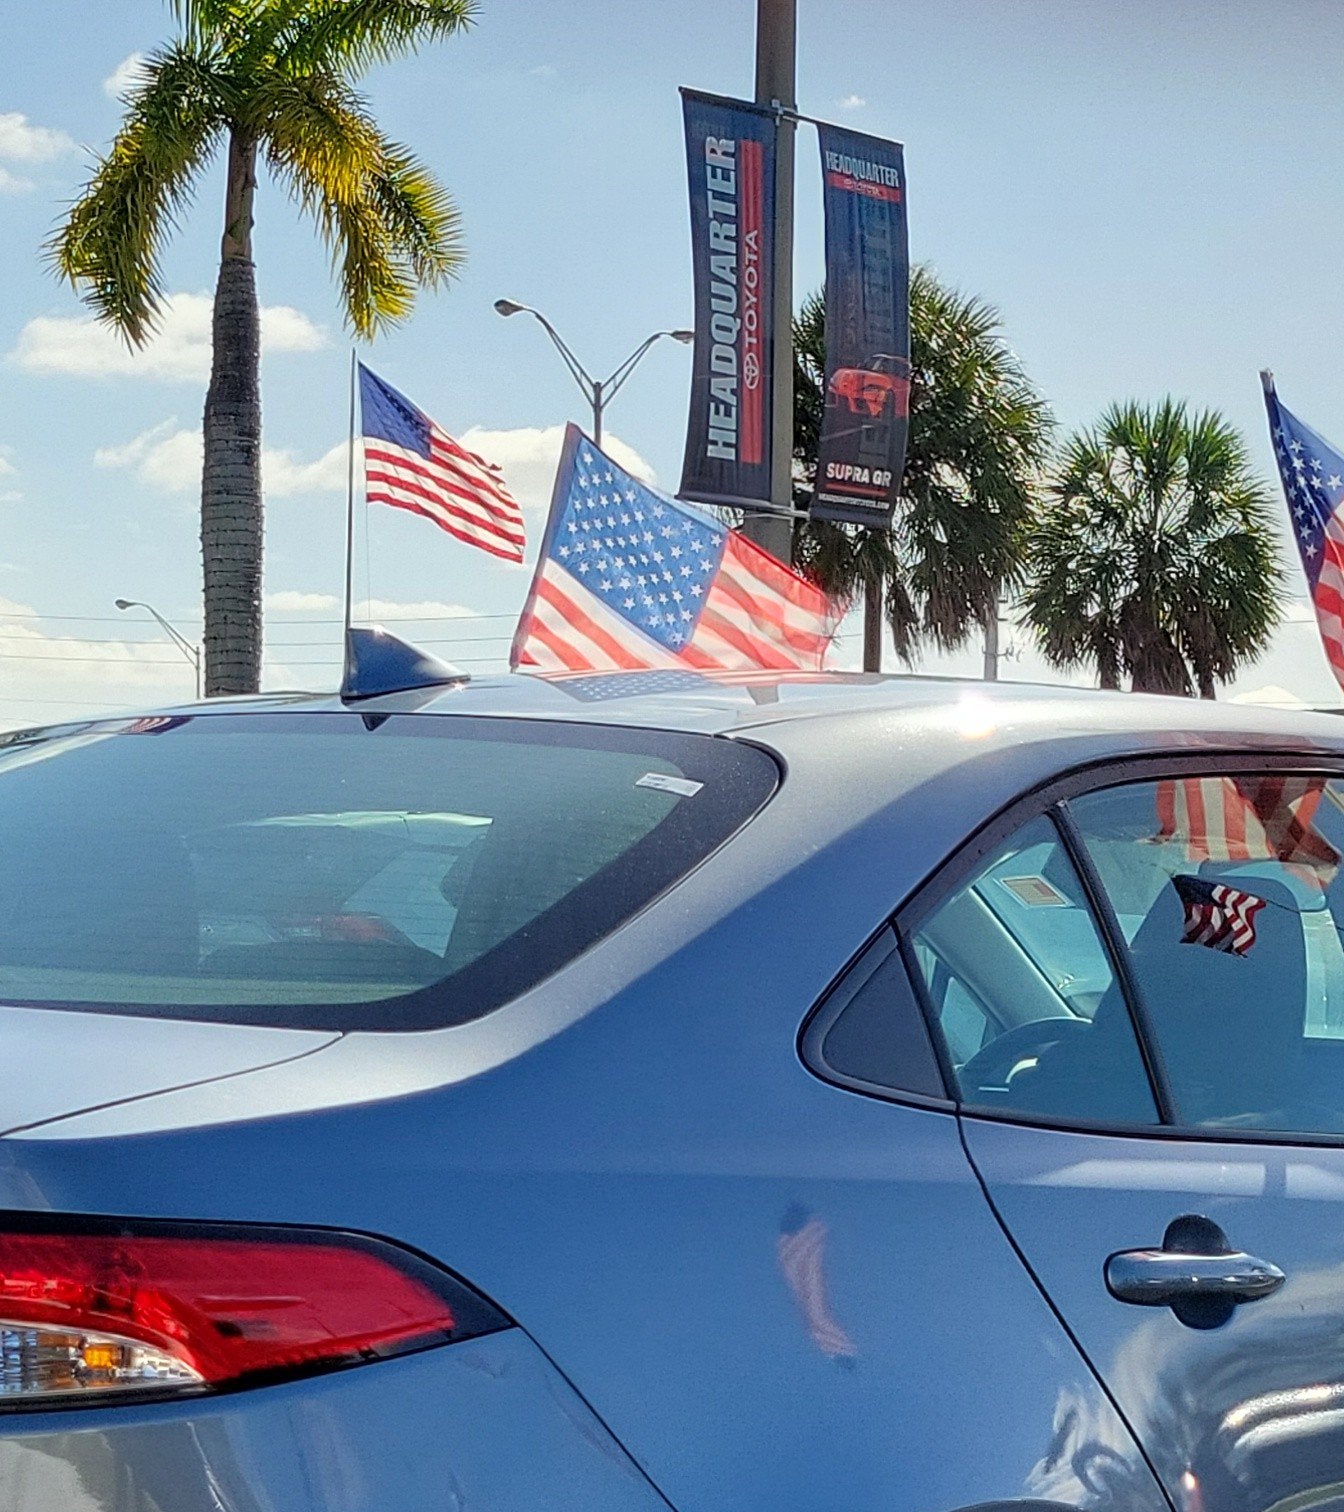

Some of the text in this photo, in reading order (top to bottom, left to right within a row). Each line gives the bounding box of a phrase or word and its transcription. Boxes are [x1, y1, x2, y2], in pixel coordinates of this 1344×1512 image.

[826, 151, 899, 187] HEADQUARTER
[706, 136, 740, 461] HEADQUARTER
[744, 230, 759, 347] TOYOTA
[826, 462, 892, 487] SUPRA GR
